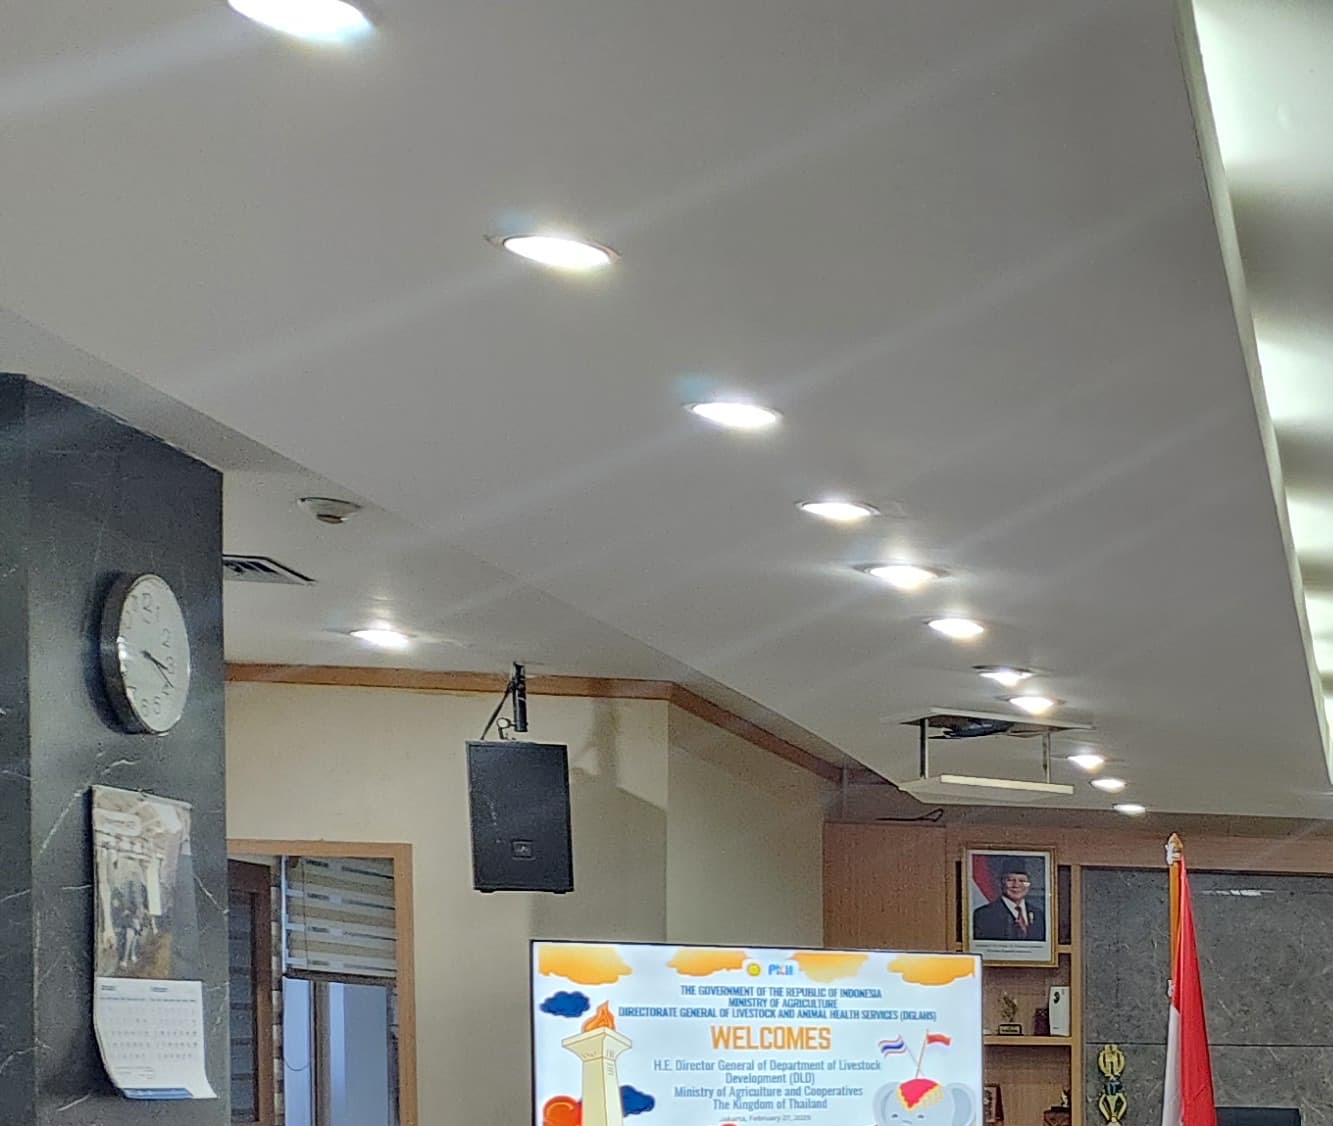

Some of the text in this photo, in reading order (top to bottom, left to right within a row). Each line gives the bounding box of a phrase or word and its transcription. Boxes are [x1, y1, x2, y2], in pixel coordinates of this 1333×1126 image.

[679, 985, 882, 998] THE GOVERNMENT OF THE REPUBLIC OF INDONESIA
[728, 997, 838, 1009] MINISTRY OF AGRICULTURE
[618, 1006, 677, 1017] DIRECTORATE
[679, 1007, 717, 1018] GENERAL
[719, 1008, 730, 1018] OF
[732, 1008, 776, 1018] LIVESTOCK
[777, 1008, 795, 1019] AND
[796, 1009, 827, 1019] ANIMAL
[829, 1009, 859, 1019] HEALTH
[861, 1009, 898, 1020] SERVICES
[710, 1025, 830, 1050] WELCOMES
[654, 1059, 881, 1073] H.E. Director General of Department of Livestock
[725, 1072, 815, 1086] Development (DLD)
[674, 1085, 863, 1099] Ministry of Agriculture and Cooperatives
[712, 1098, 827, 1112] The Kingdom of Thailand
